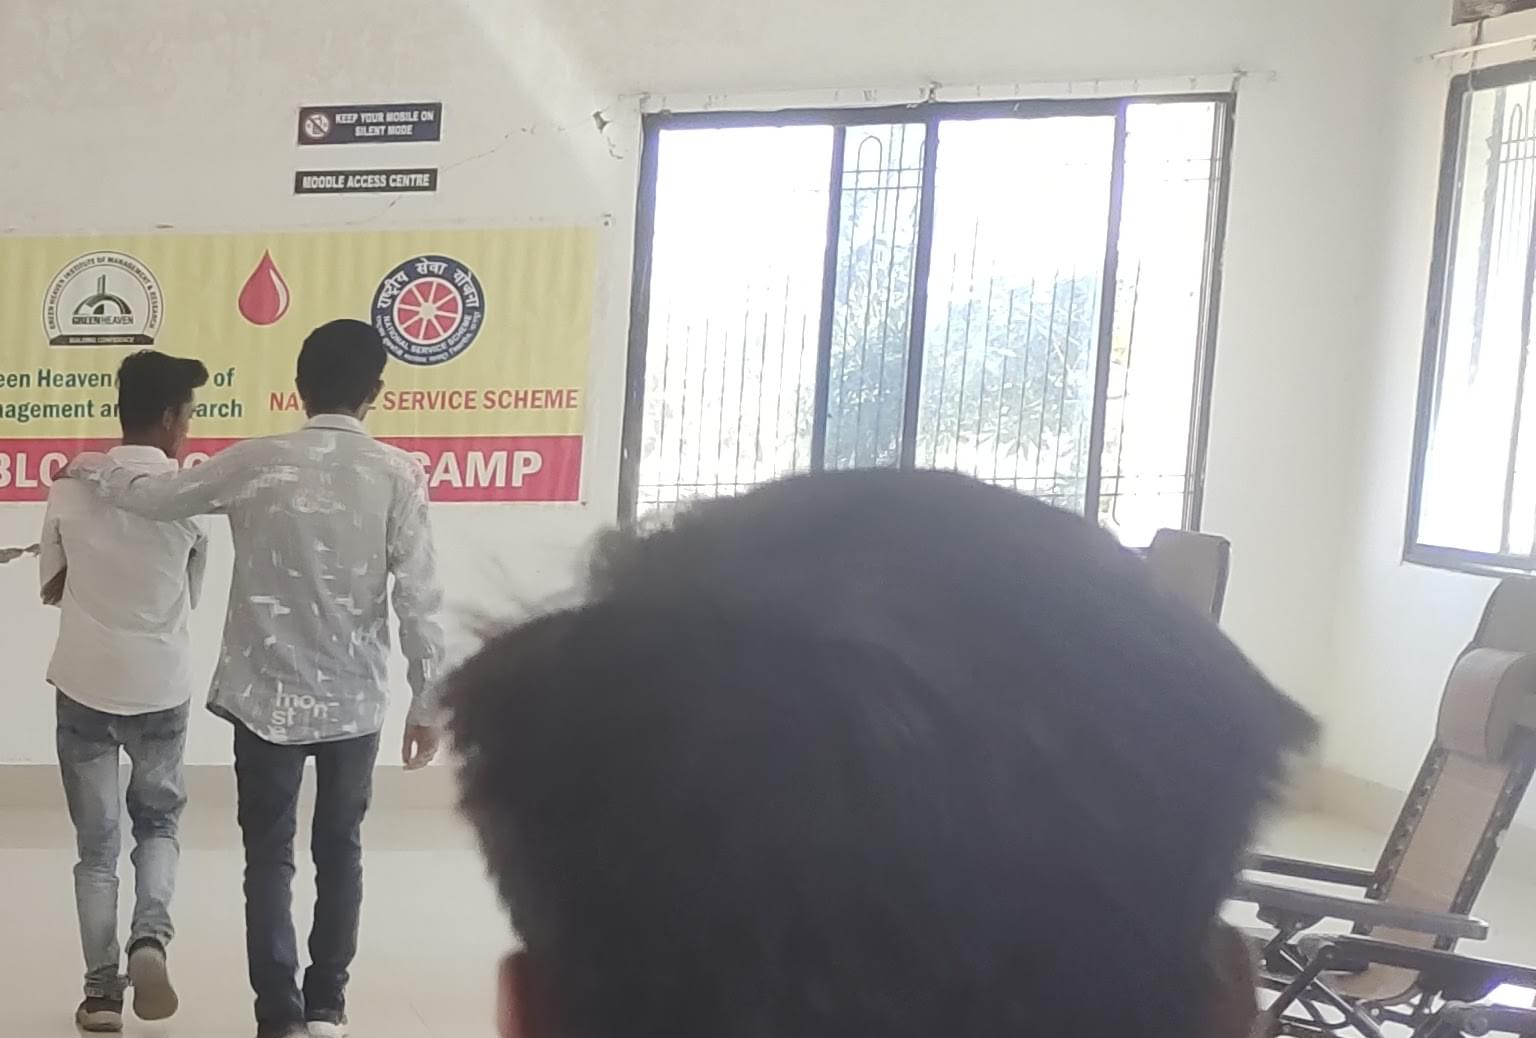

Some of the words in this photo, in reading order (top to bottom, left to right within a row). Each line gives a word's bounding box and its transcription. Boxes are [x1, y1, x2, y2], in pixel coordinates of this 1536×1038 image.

[335, 113, 358, 124] KEEP
[361, 112, 384, 123] YOUR
[386, 111, 418, 122] MOBILE
[420, 111, 434, 121] ON
[355, 125, 385, 137] SILENT
[387, 124, 413, 136] MODE
[302, 175, 344, 189] MOODLE
[346, 174, 387, 188] ACCESS
[389, 174, 430, 187] CENTRE
[415, 257, 449, 275] सेवा
[37, 368, 112, 387] Heaven
[213, 367, 235, 387] of
[383, 389, 477, 410] SERVICE
[483, 389, 578, 409] SCHEME
